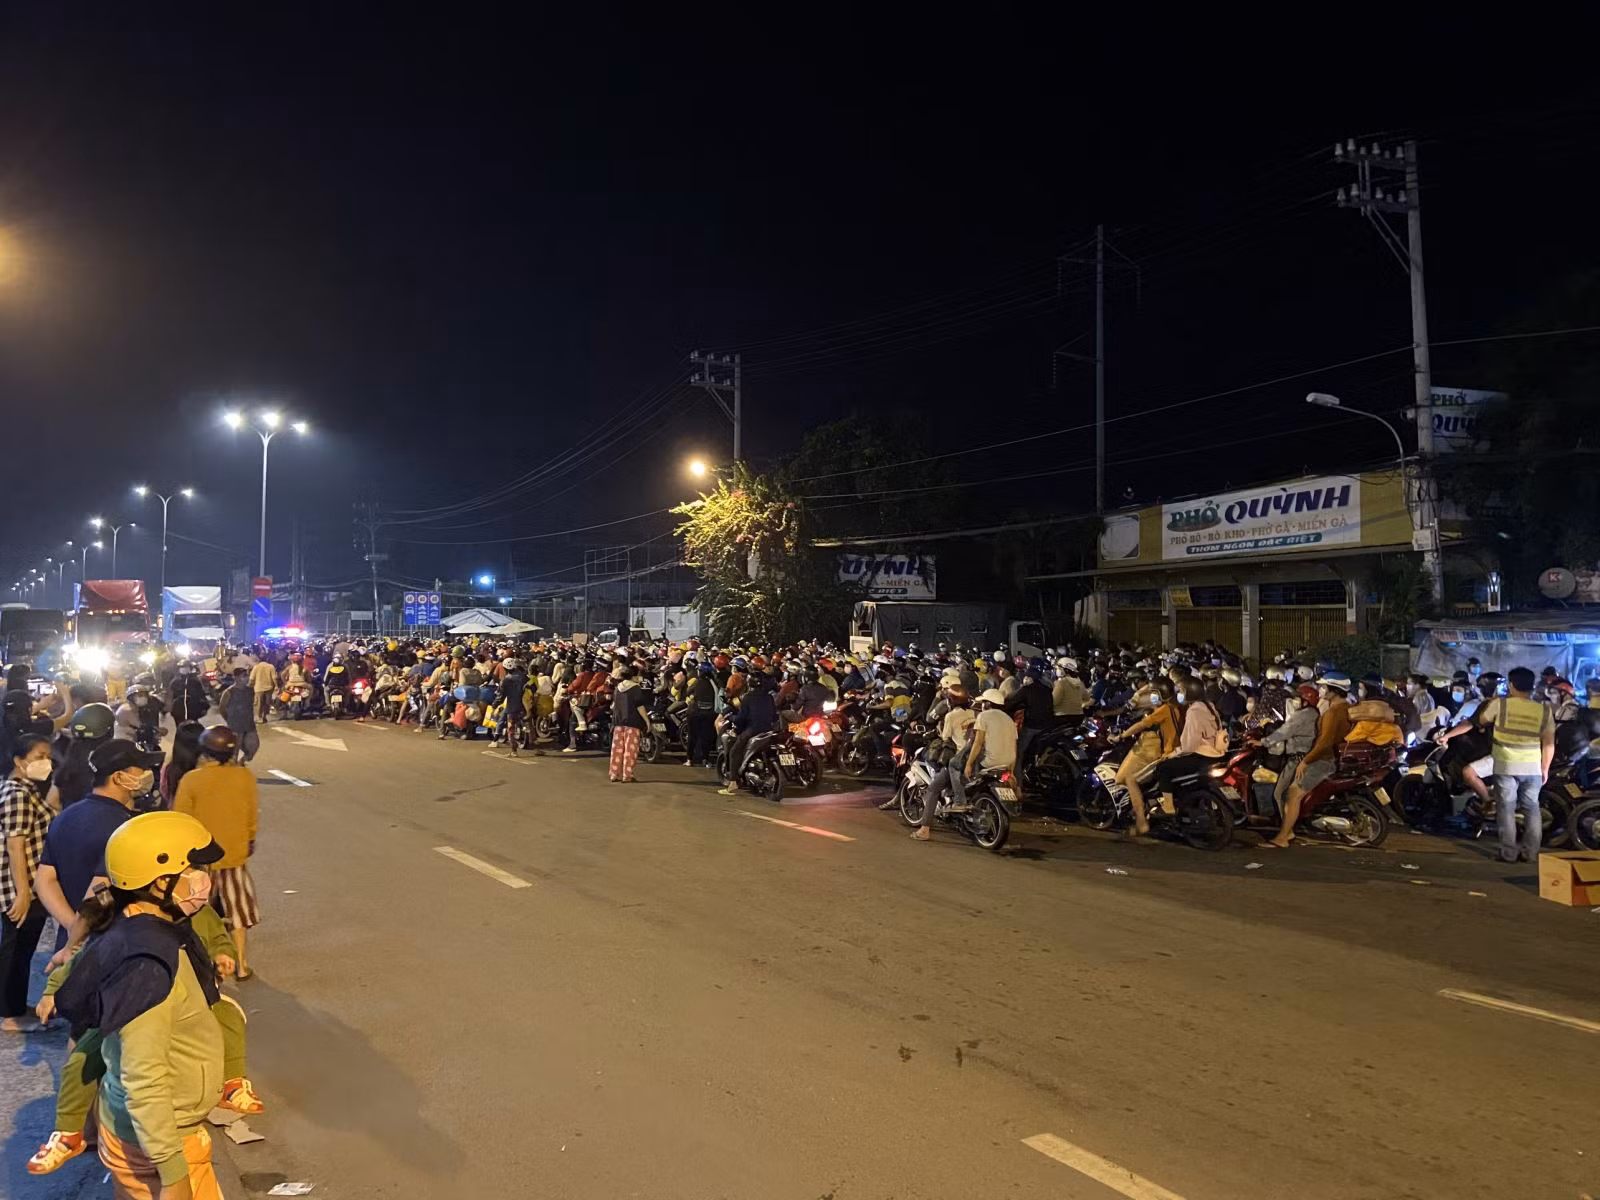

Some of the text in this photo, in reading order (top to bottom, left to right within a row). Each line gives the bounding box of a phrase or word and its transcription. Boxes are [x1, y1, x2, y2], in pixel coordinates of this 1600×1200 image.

[1170, 485, 1351, 525] PHỞ QUỲNH
[1225, 529, 1245, 539] KHO
